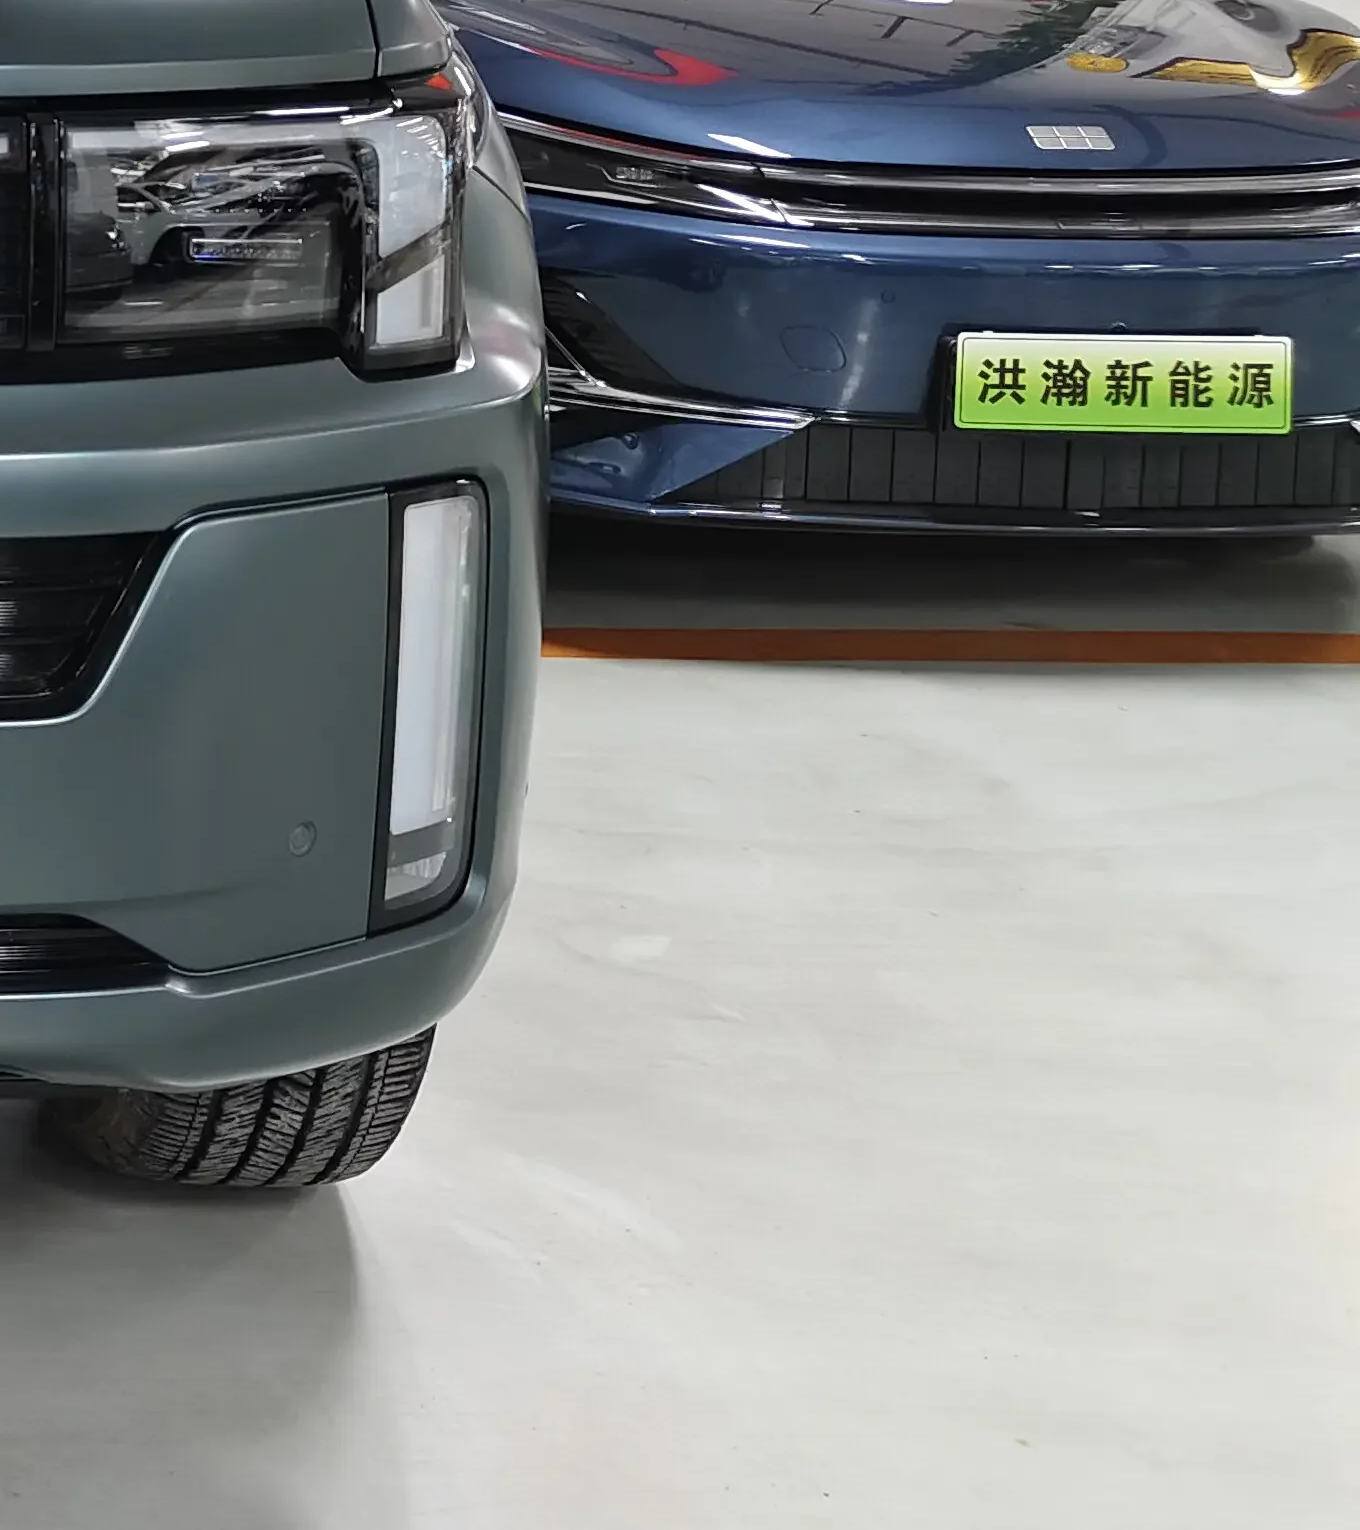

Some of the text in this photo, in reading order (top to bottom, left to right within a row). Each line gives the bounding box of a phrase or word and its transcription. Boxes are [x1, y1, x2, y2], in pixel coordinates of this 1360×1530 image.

[977, 358, 1275, 409] 洪瀚新能源
